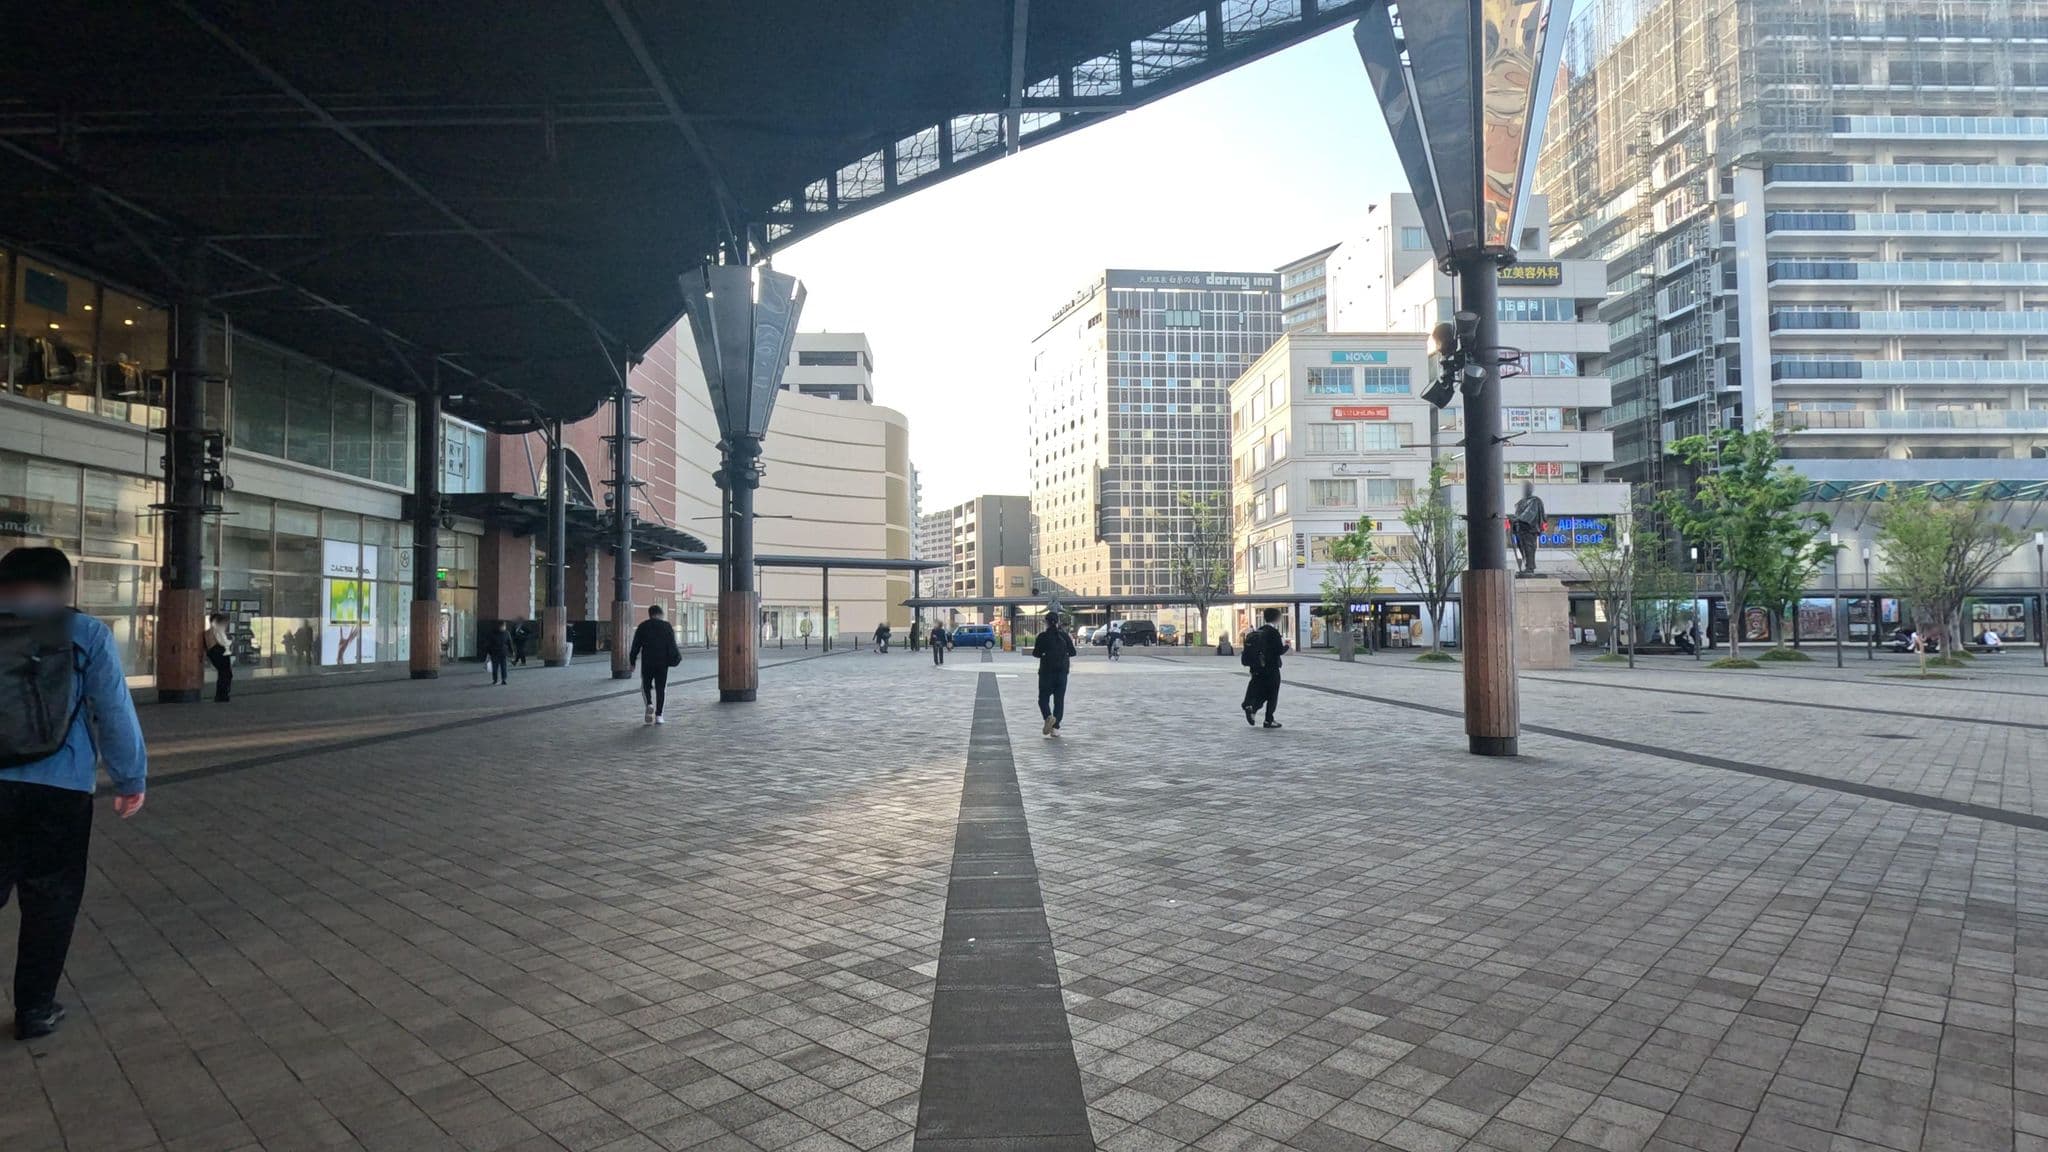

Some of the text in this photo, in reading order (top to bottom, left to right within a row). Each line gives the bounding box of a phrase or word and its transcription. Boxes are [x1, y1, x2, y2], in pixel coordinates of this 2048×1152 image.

[1206, 272, 1273, 289] dormy inn
[1345, 352, 1374, 361] NOVA
